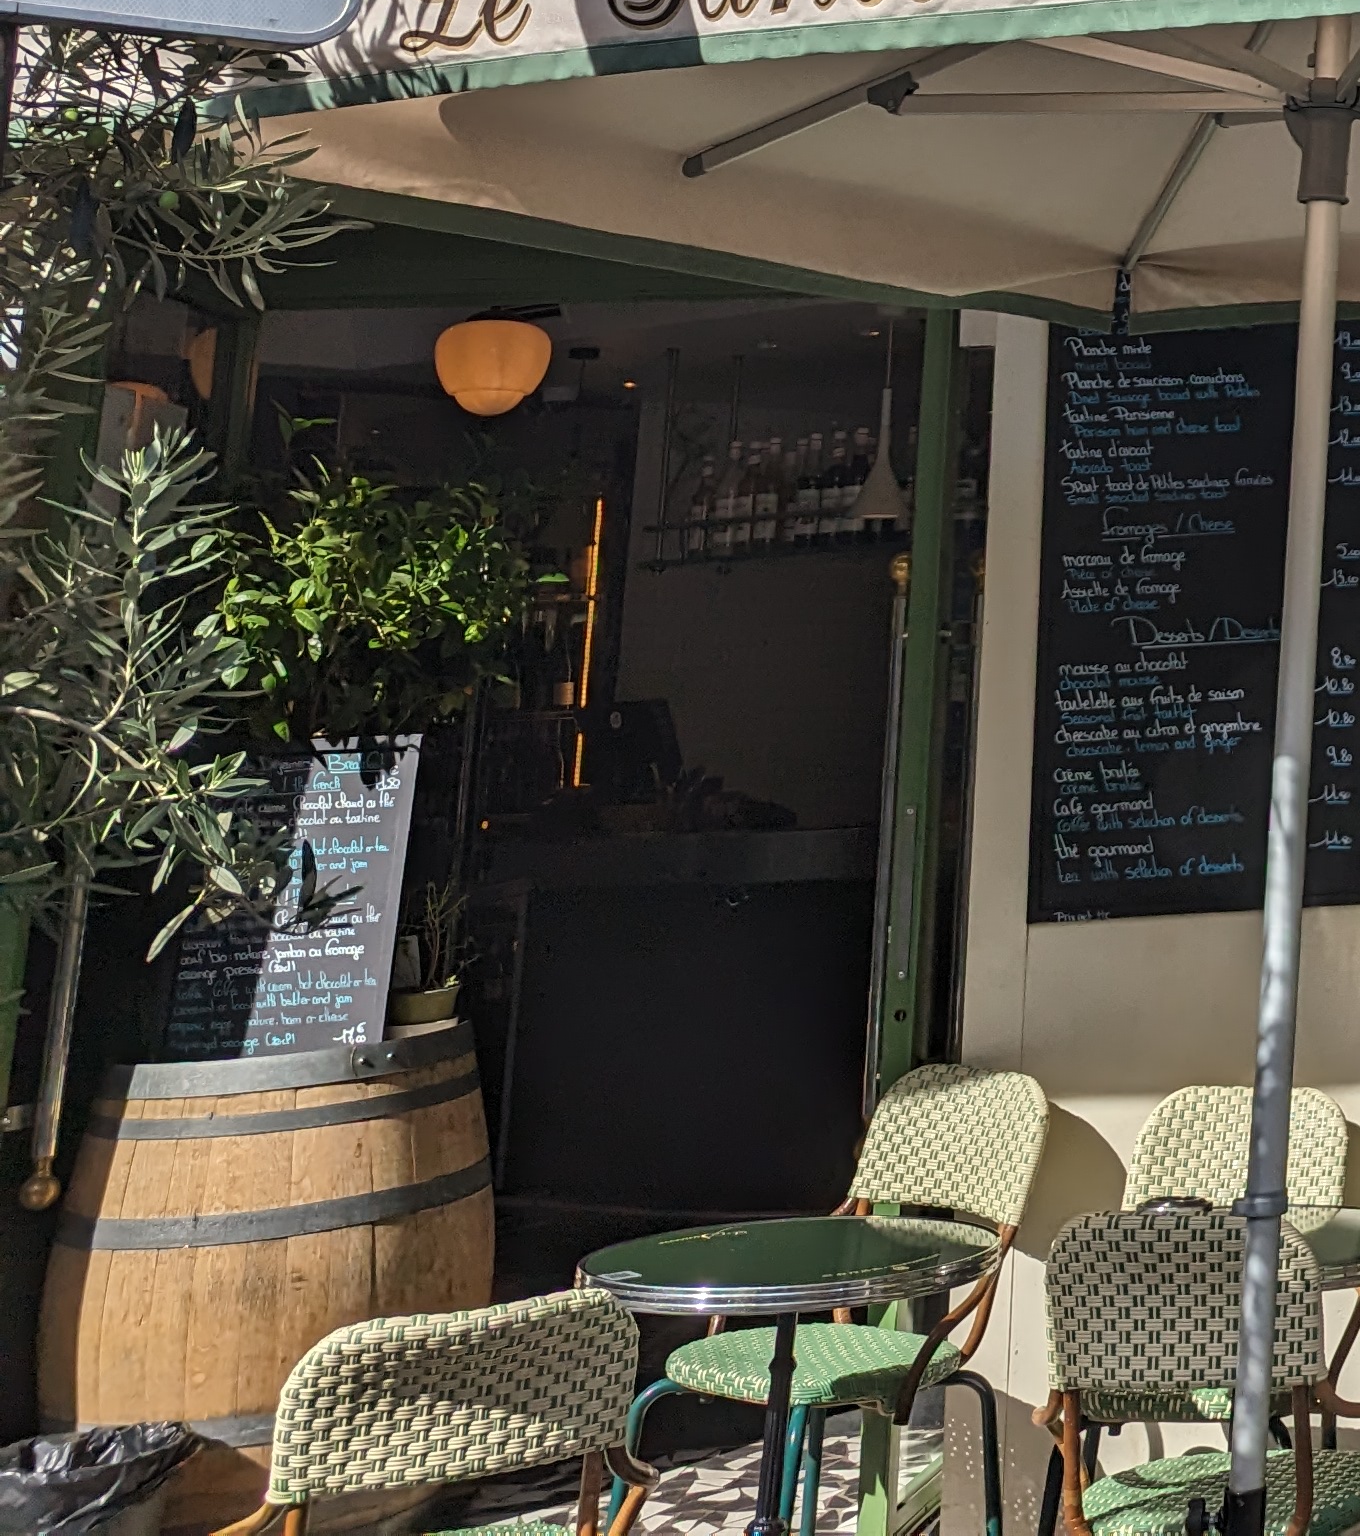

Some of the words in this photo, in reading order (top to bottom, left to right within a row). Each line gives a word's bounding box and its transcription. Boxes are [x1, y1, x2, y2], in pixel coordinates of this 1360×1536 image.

[1061, 371, 1114, 389] Planche
[1119, 545, 1135, 565] de
[1115, 578, 1129, 594] de
[1188, 684, 1202, 703] de
